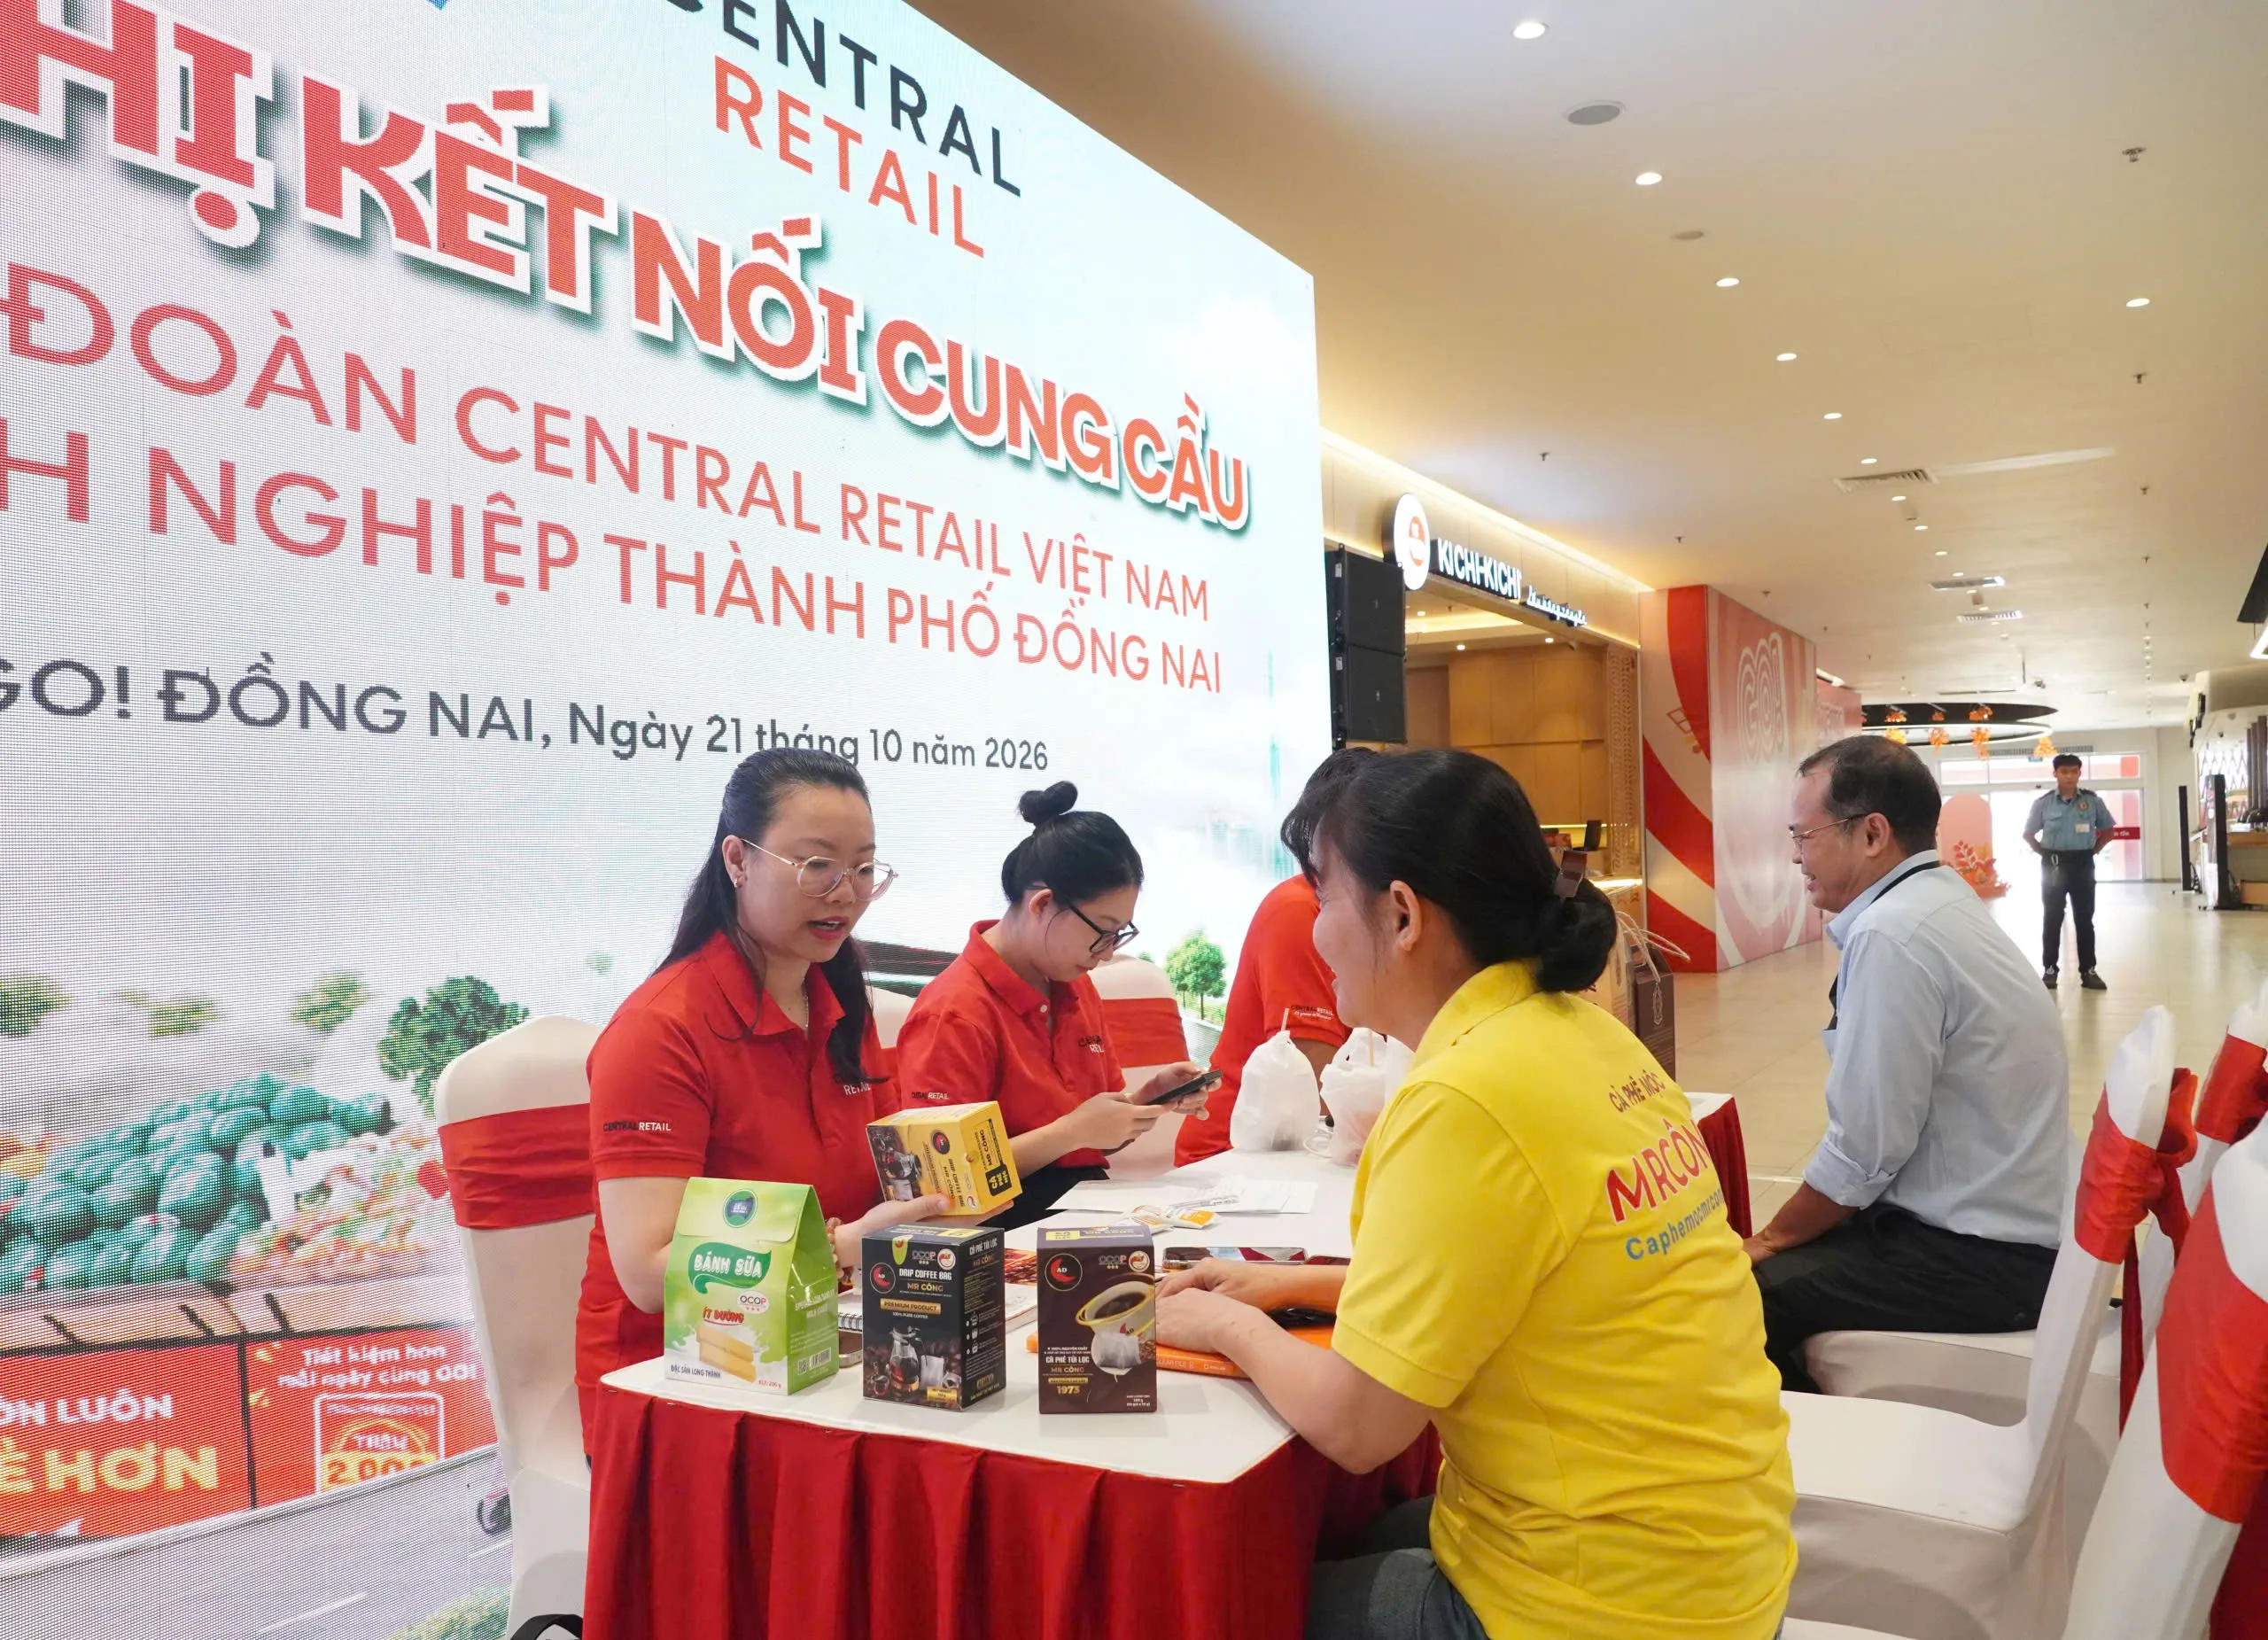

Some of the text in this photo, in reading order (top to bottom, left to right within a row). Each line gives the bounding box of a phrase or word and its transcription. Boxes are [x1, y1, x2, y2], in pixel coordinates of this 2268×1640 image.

[667, 0, 1021, 198] ENTRAL
[714, 55, 984, 259] RETAIL
[301, 88, 608, 299] KẾT
[632, 216, 859, 395] NỐI
[875, 318, 1114, 481] CUNG
[1122, 392, 1244, 524] CẦU
[0, 261, 1208, 621] ĐOÀN CENTRAL RETAIL VIỆT NAM
[149, 446, 579, 606] NGHIỆP
[602, 532, 866, 640] THÀNH
[887, 579, 1002, 658] PHỐ
[1014, 595, 1149, 681] ĐỒNG
[1161, 641, 1222, 694] NAI
[1437, 538, 1522, 600] KICHI-KICHI
[157, 651, 408, 735] ĐỒNG
[429, 691, 551, 750] NAI,
[570, 703, 694, 762] Ngày
[706, 716, 742, 755] 21
[755, 719, 858, 767] tháng
[869, 728, 902, 762] 10
[913, 734, 975, 767] năm
[984, 736, 1048, 771] 2026
[1609, 1084, 1628, 1113] CÀ
[1623, 1075, 1646, 1107] PHÊ
[694, 1251, 762, 1278] BÁNH SỮA
[899, 1268, 951, 1280] DRIP COFFEE BAG
[921, 1282, 943, 1292] CÔNG
[740, 1295, 767, 1305] OCOP
[691, 1368, 703, 1377] LONG
[56, 1387, 175, 1424] LUÔN
[43, 1441, 219, 1494] HƠN
